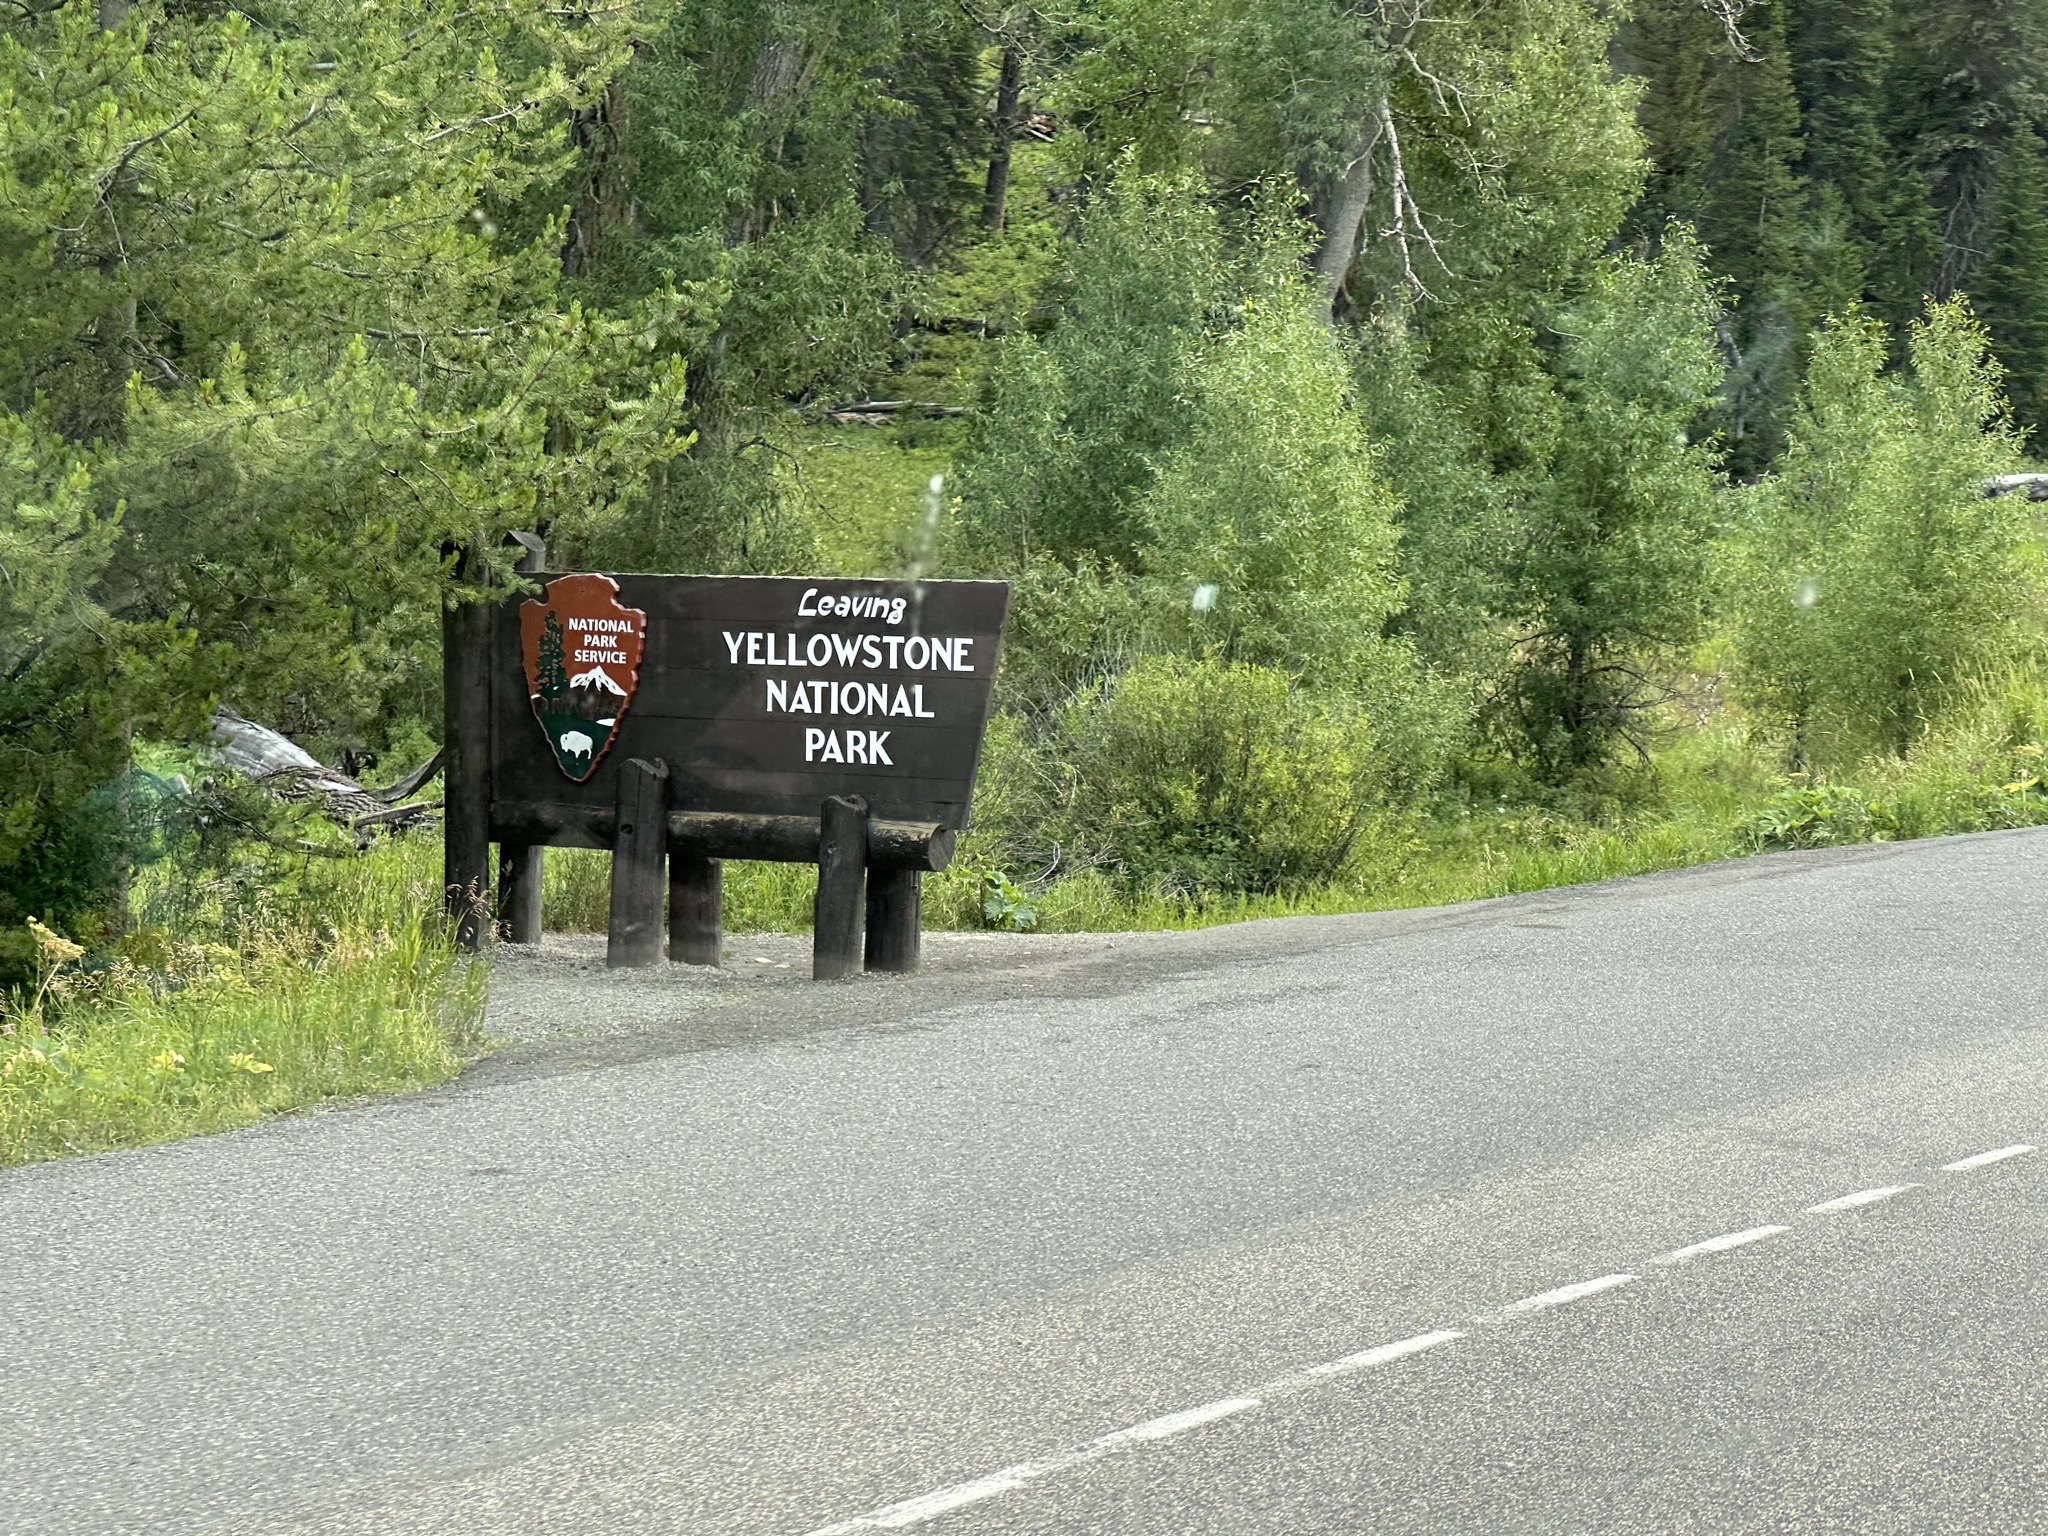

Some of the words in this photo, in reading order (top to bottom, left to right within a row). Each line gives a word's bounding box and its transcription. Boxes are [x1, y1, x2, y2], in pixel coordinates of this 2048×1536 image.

[568, 617, 635, 633] NATIONAL
[797, 587, 908, 626] Leaving
[574, 649, 627, 664] SERVICE
[583, 634, 618, 648] PARK
[721, 631, 975, 672] YELLOWSTONE
[766, 679, 935, 719] NATIONAL
[805, 727, 894, 766] PARK
